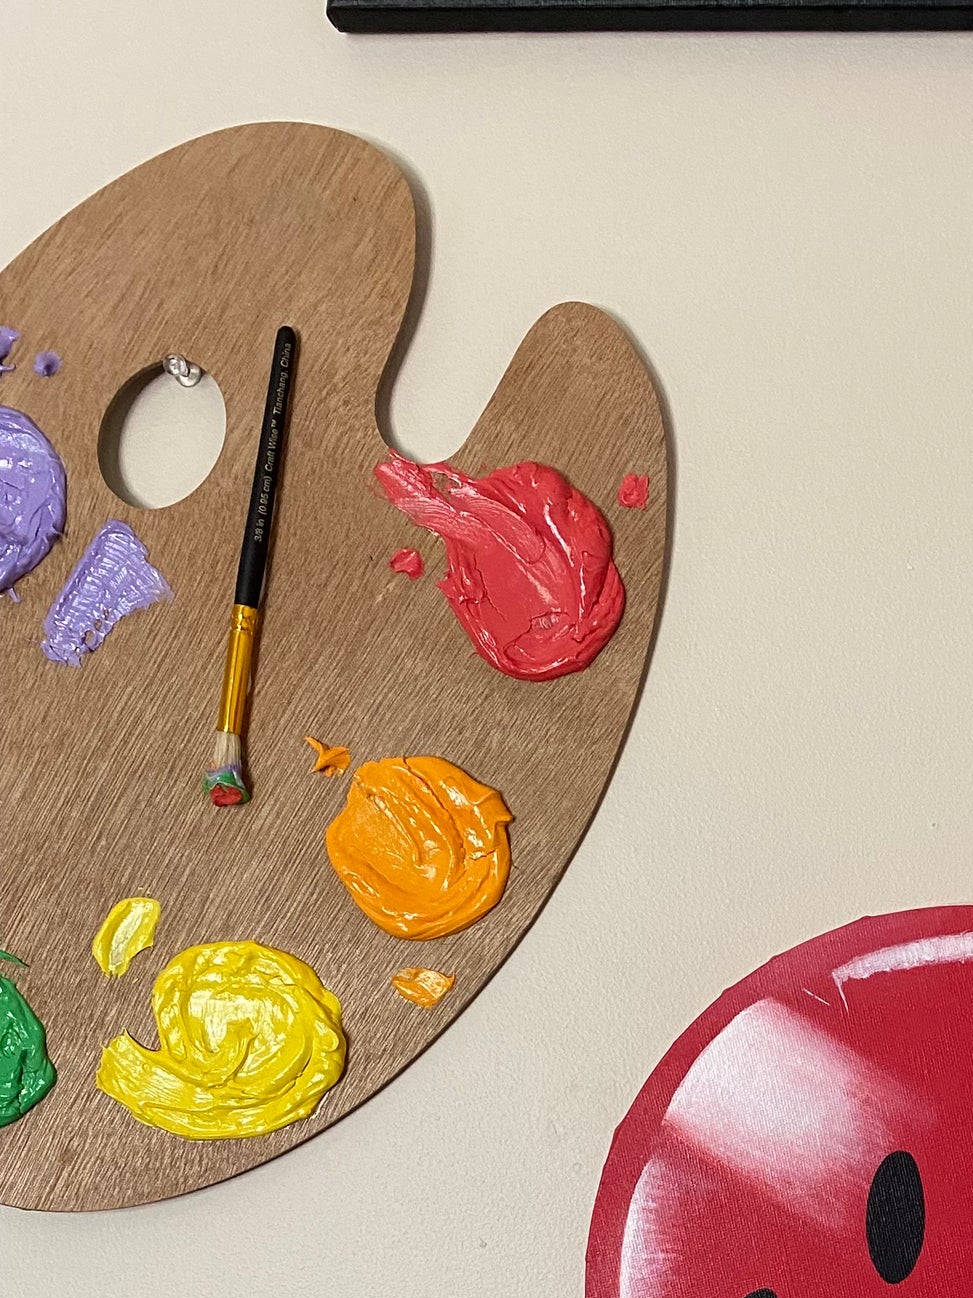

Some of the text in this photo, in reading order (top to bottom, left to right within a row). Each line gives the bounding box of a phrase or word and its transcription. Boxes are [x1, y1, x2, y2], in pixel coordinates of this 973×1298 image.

[281, 343, 291, 367] China
[265, 450, 275, 472] Craft
[263, 475, 272, 493] cm)
[256, 518, 265, 527] in
[254, 528, 263, 542] 3/8
